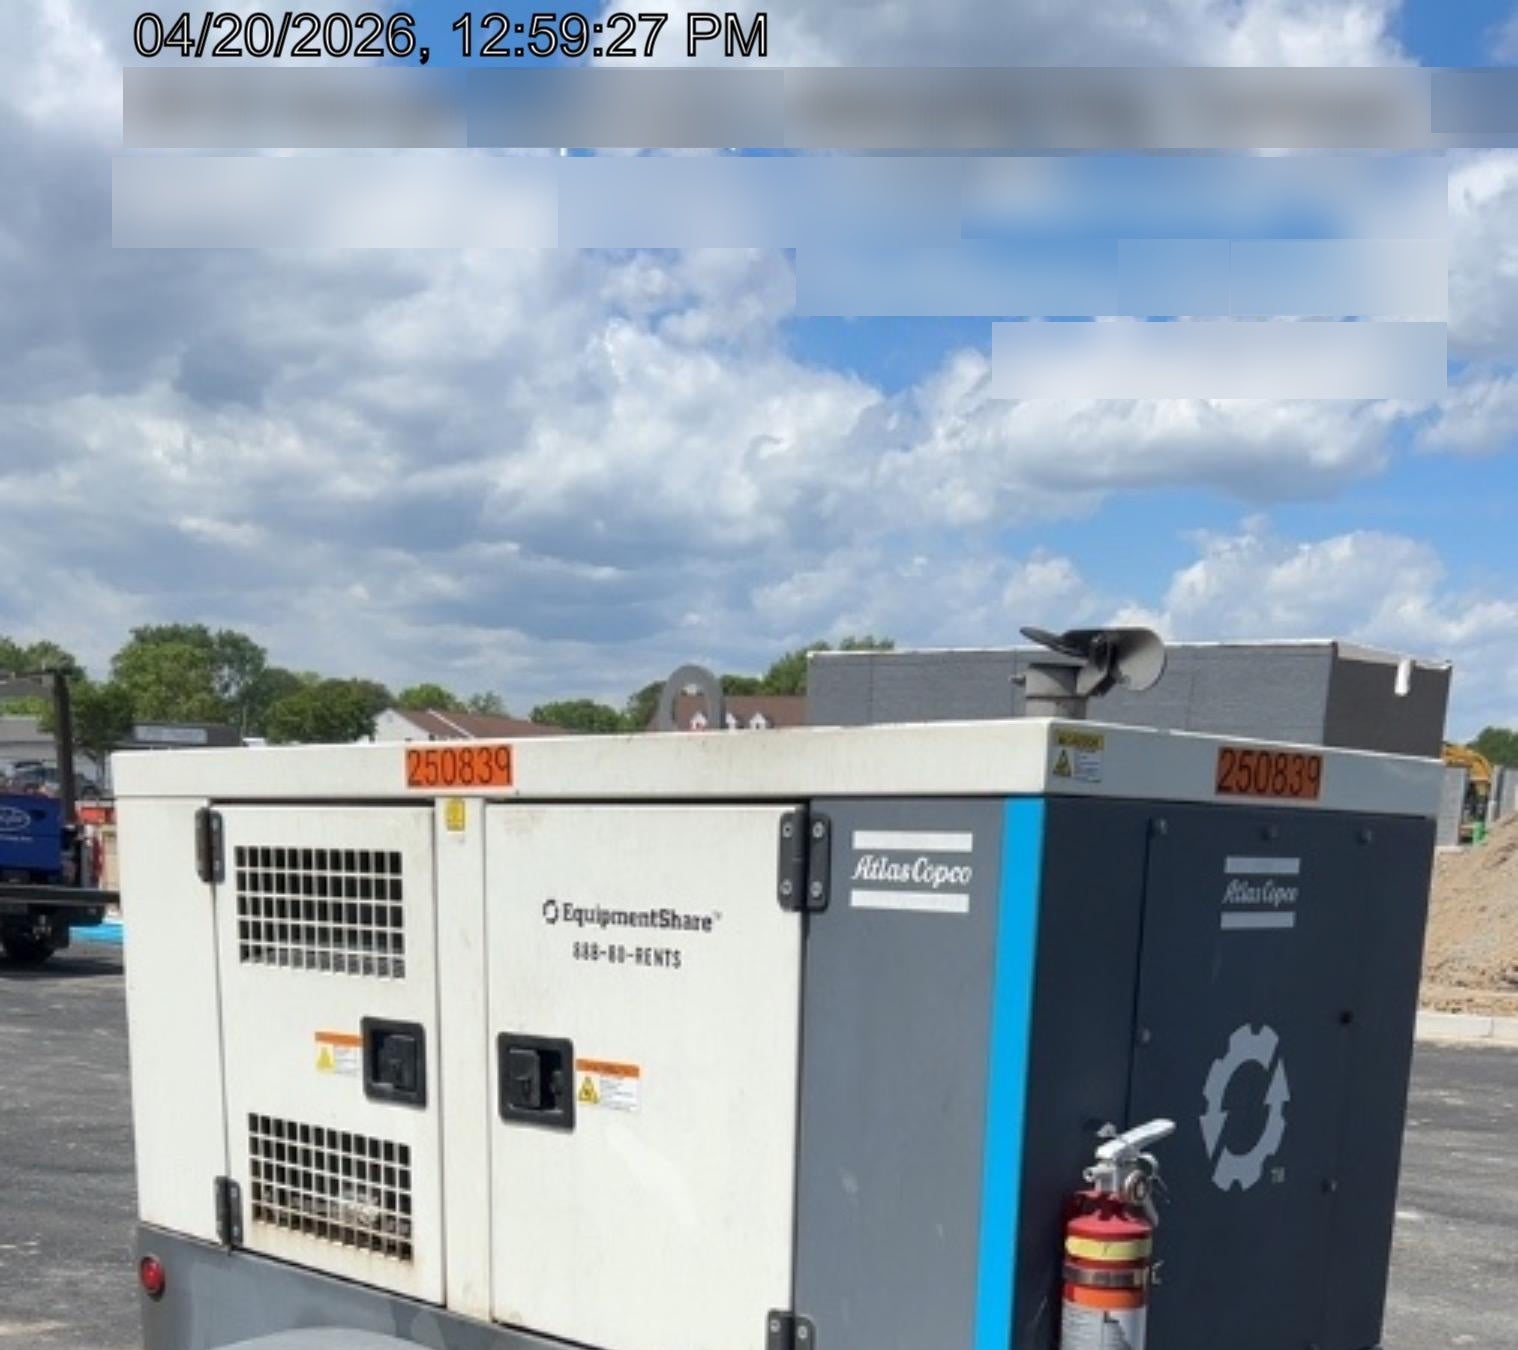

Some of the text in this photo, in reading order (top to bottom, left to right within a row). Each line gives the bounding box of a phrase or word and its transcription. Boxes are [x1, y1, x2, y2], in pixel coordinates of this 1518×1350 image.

[407, 745, 511, 787] 250839
[1218, 750, 1321, 798] 250839
[851, 855, 972, 888] Atlas Copco
[1222, 878, 1260, 904] Atlas
[562, 902, 712, 933] EquipmentShare
